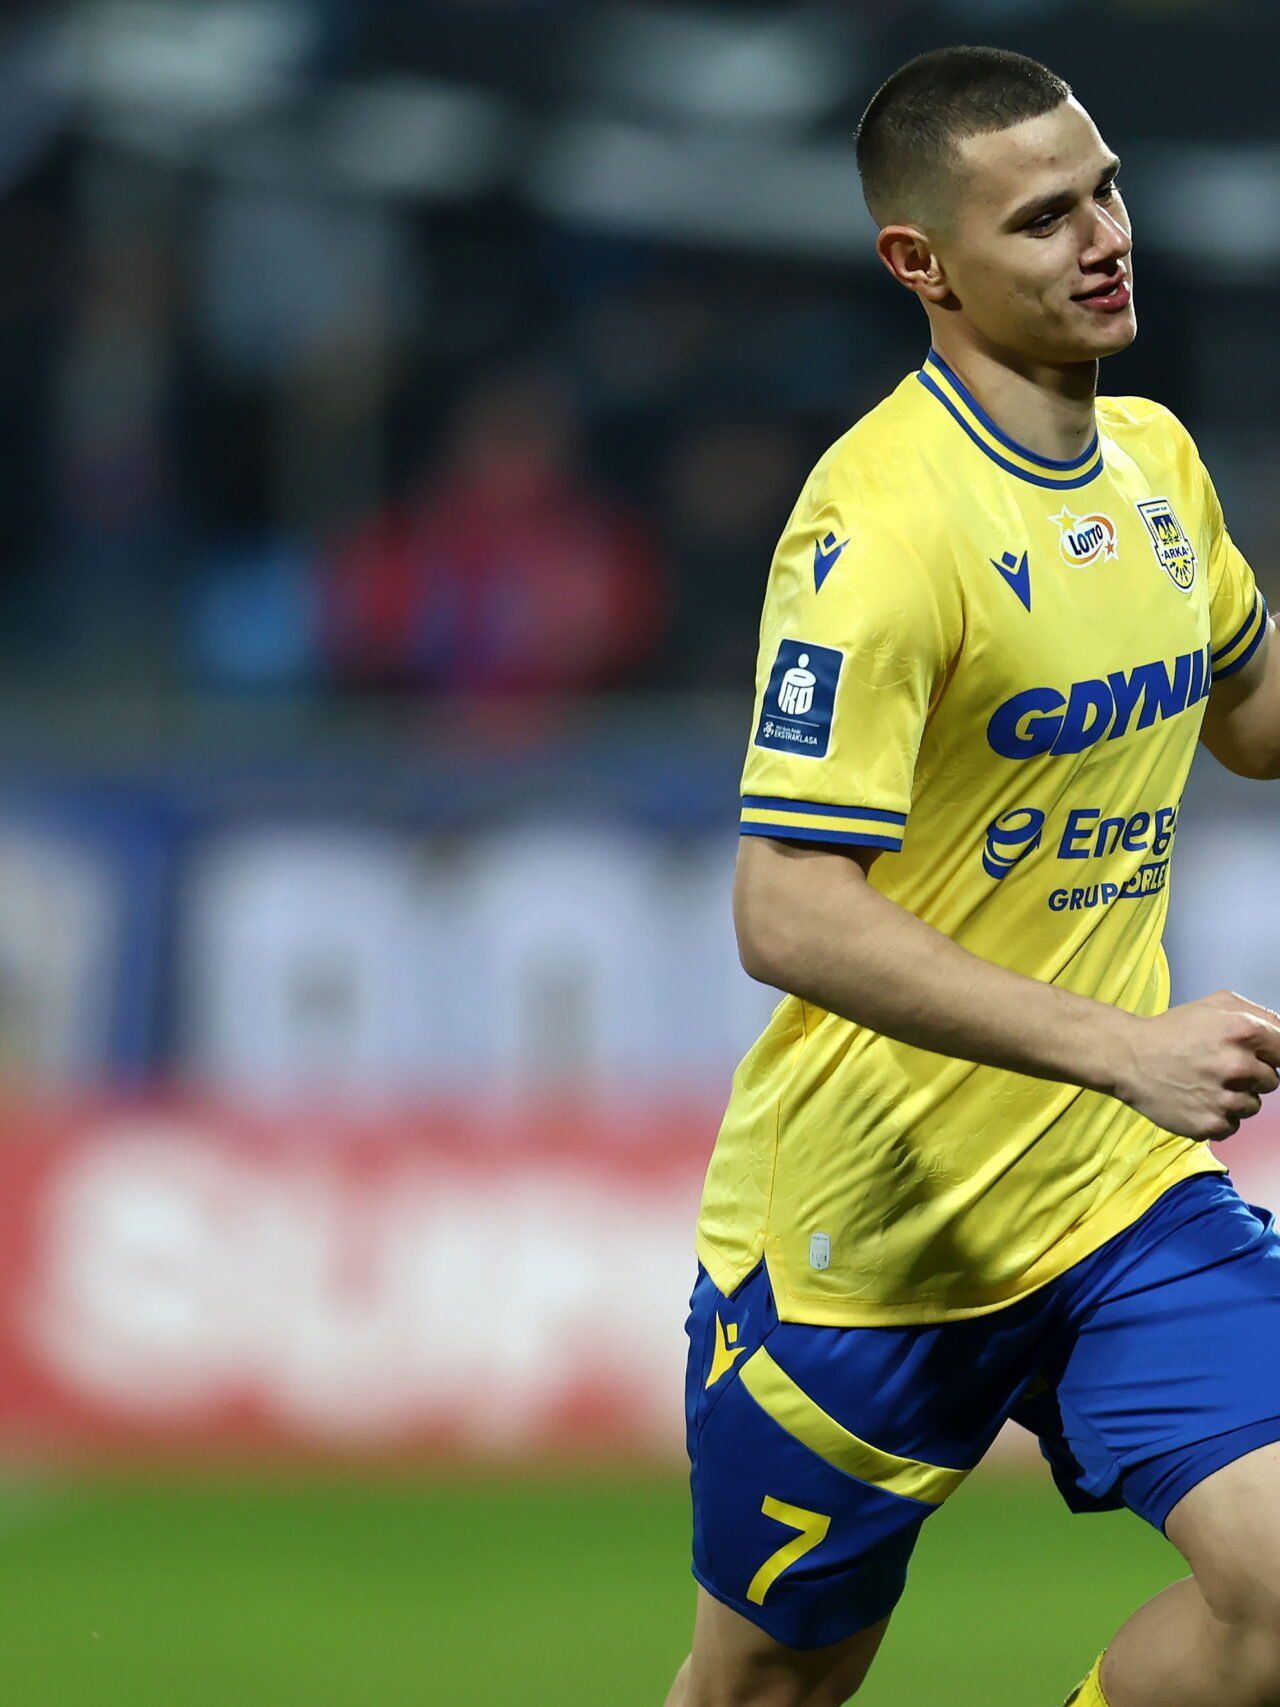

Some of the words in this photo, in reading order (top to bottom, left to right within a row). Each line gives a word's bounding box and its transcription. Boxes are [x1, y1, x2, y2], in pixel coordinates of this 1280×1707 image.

[1068, 523, 1103, 556] LOTTO
[1163, 546, 1189, 560] ARKA
[986, 642, 1211, 760] GDYNI
[774, 729, 818, 745] EKSTRAKLASA
[1048, 883, 1119, 912] GRUP
[746, 1495, 832, 1606] 7
